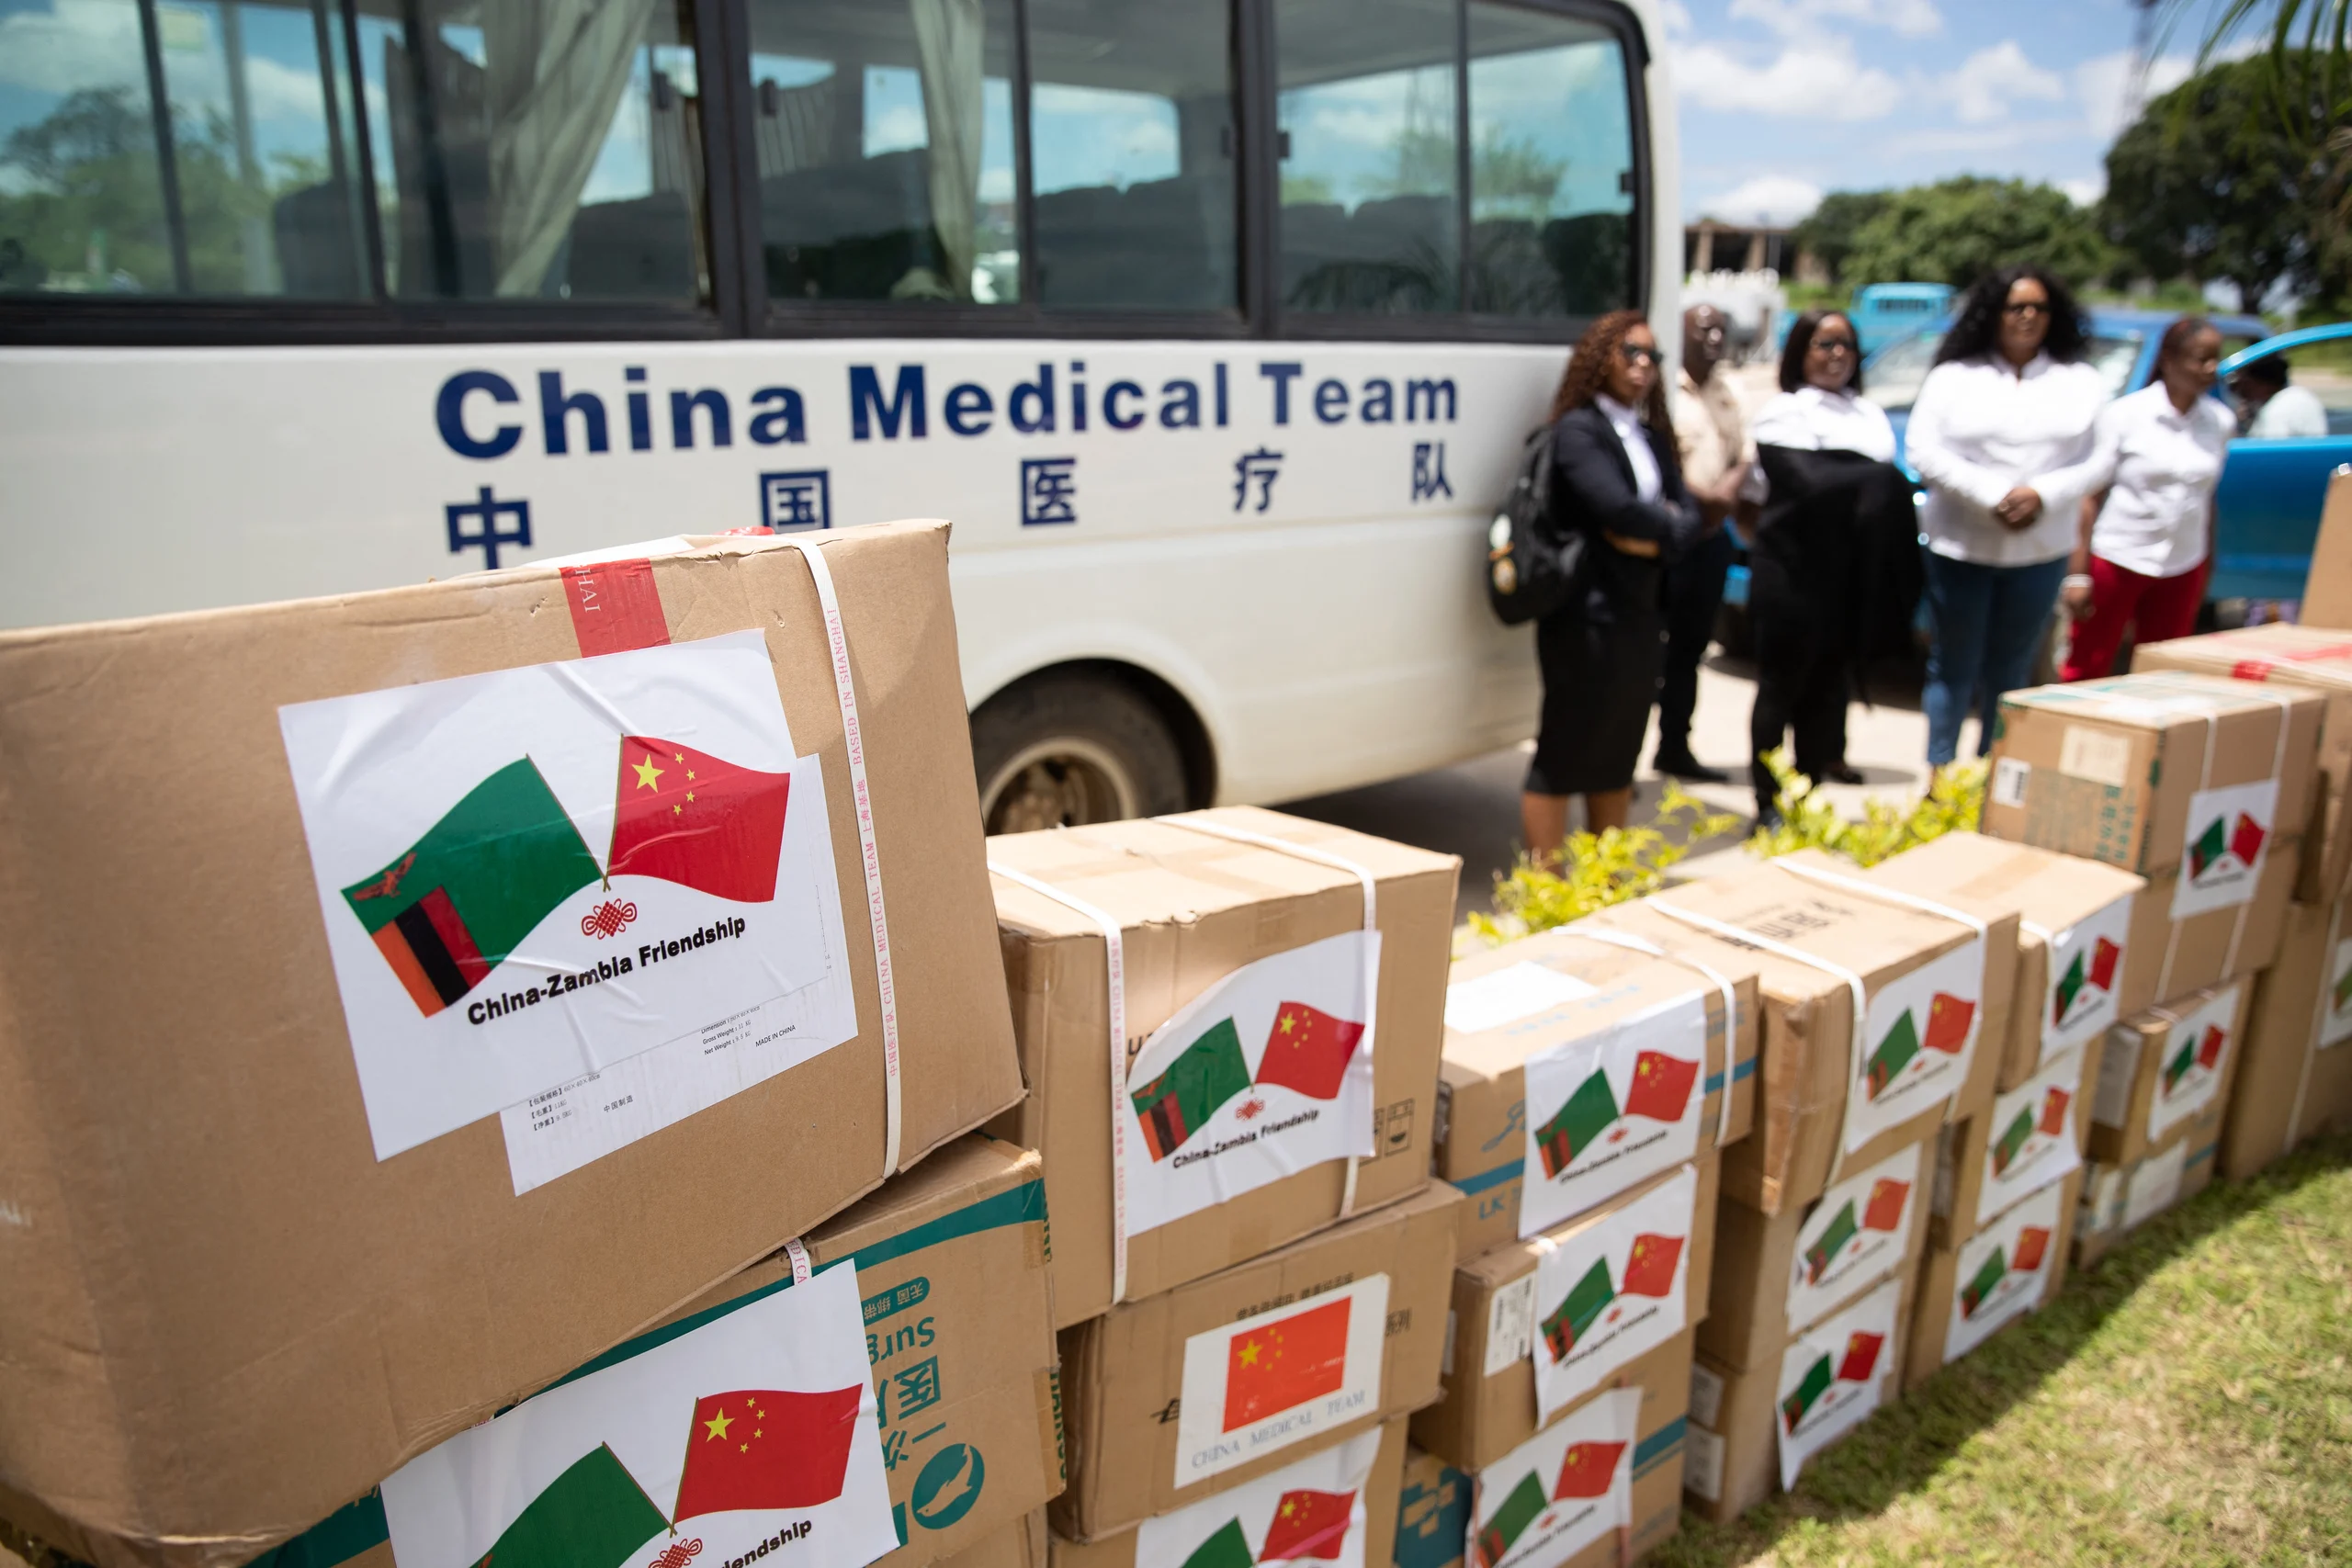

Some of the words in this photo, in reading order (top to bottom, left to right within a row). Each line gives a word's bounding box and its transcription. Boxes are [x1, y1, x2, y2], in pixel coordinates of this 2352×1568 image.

[435, 365, 808, 459] China
[847, 360, 1229, 441] Medical
[1259, 361, 1460, 427] Team
[827, 609, 850, 684] SHANGHAI
[842, 691, 854, 709] IN
[848, 716, 862, 765] BASED
[865, 841, 878, 880] TEAM
[872, 886, 888, 953] MEDICAL
[468, 956, 633, 1026] China-Zambia
[639, 916, 746, 968] Friendship
[880, 958, 893, 1005] CHINA
[755, 1036, 772, 1047] MADE
[778, 1024, 797, 1037] CHINA
[603, 1094, 634, 1113] 中国制造
[1191, 1439, 1240, 1470] CHINA
[1250, 1410, 1312, 1449] MEDICAL
[1328, 1389, 1366, 1416] TEAM
